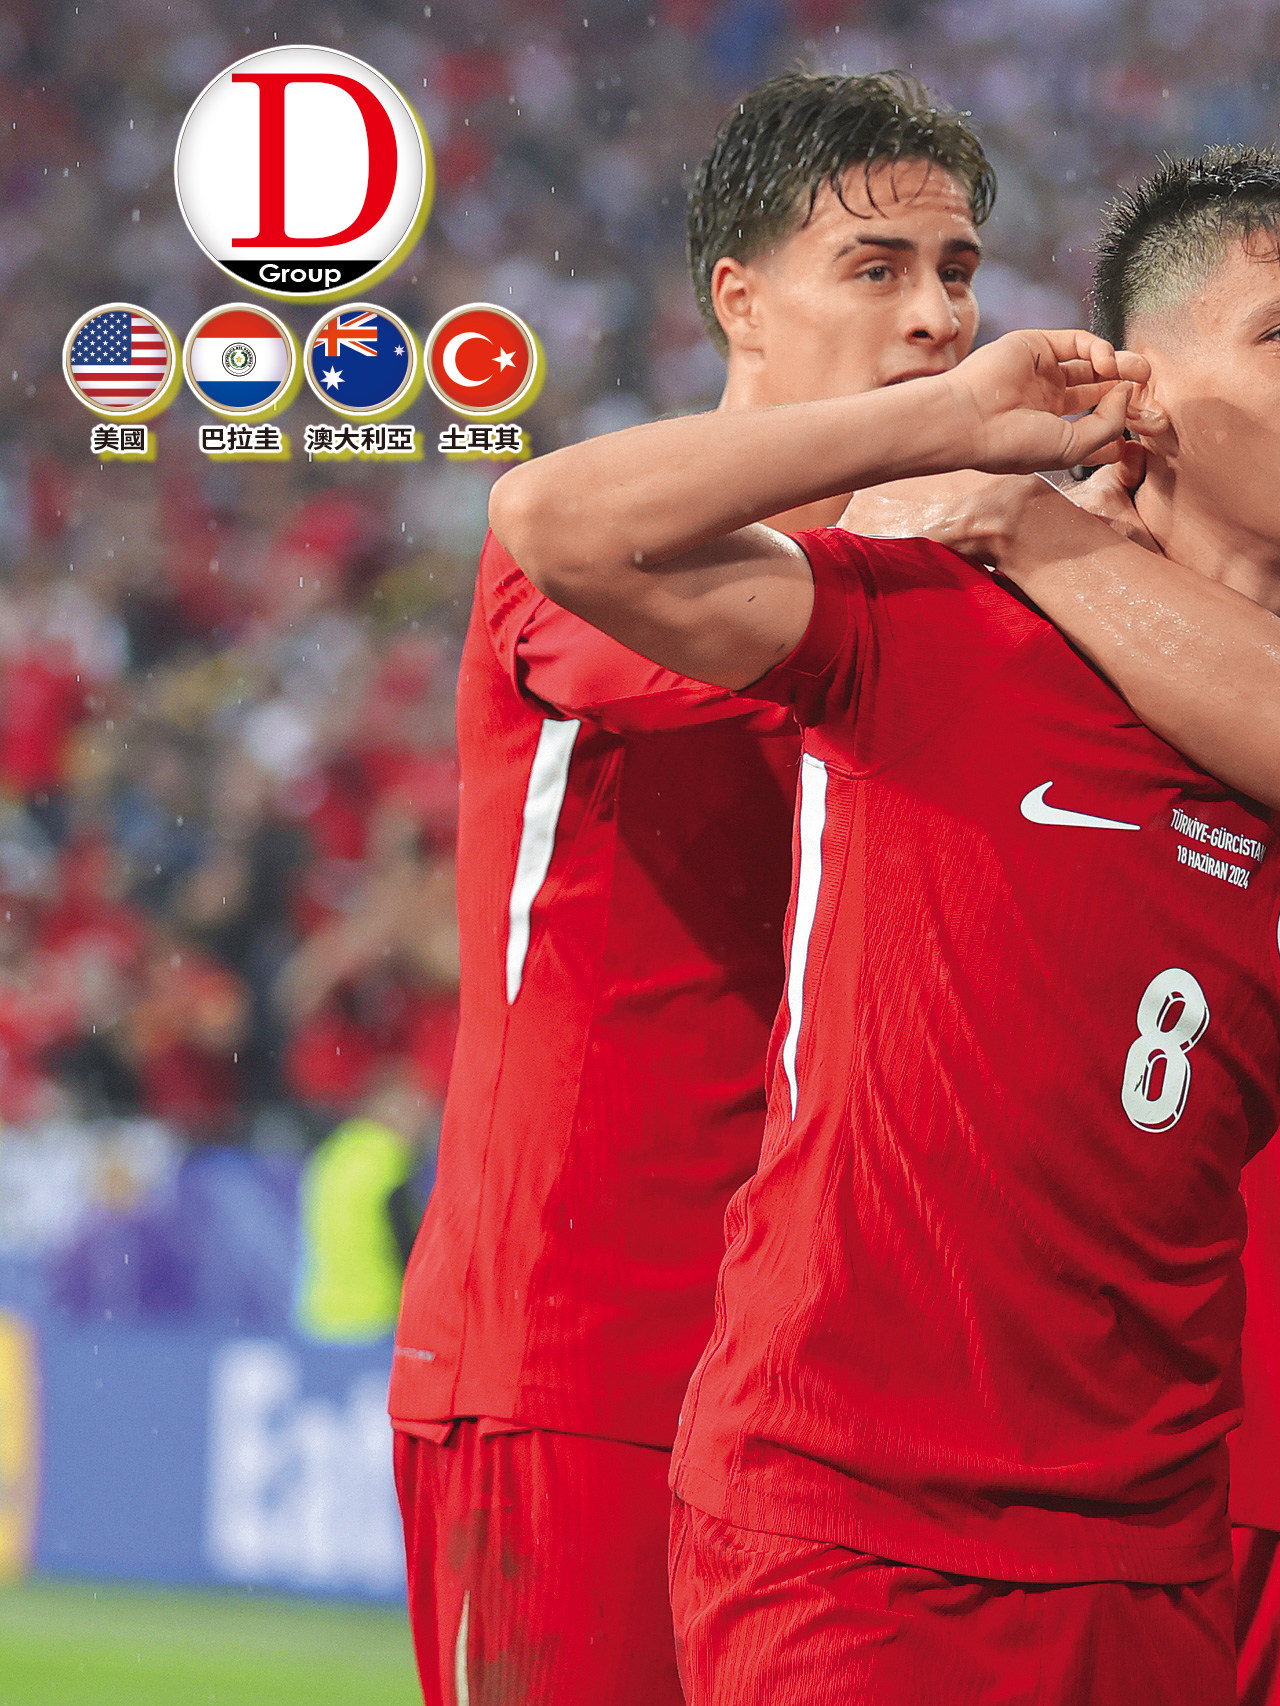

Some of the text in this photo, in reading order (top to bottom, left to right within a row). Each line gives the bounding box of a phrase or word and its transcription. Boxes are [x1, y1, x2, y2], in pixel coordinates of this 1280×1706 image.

[1177, 845, 1251, 890] 18 HAZİRAN 2024
[1121, 967, 1210, 1134] 8
